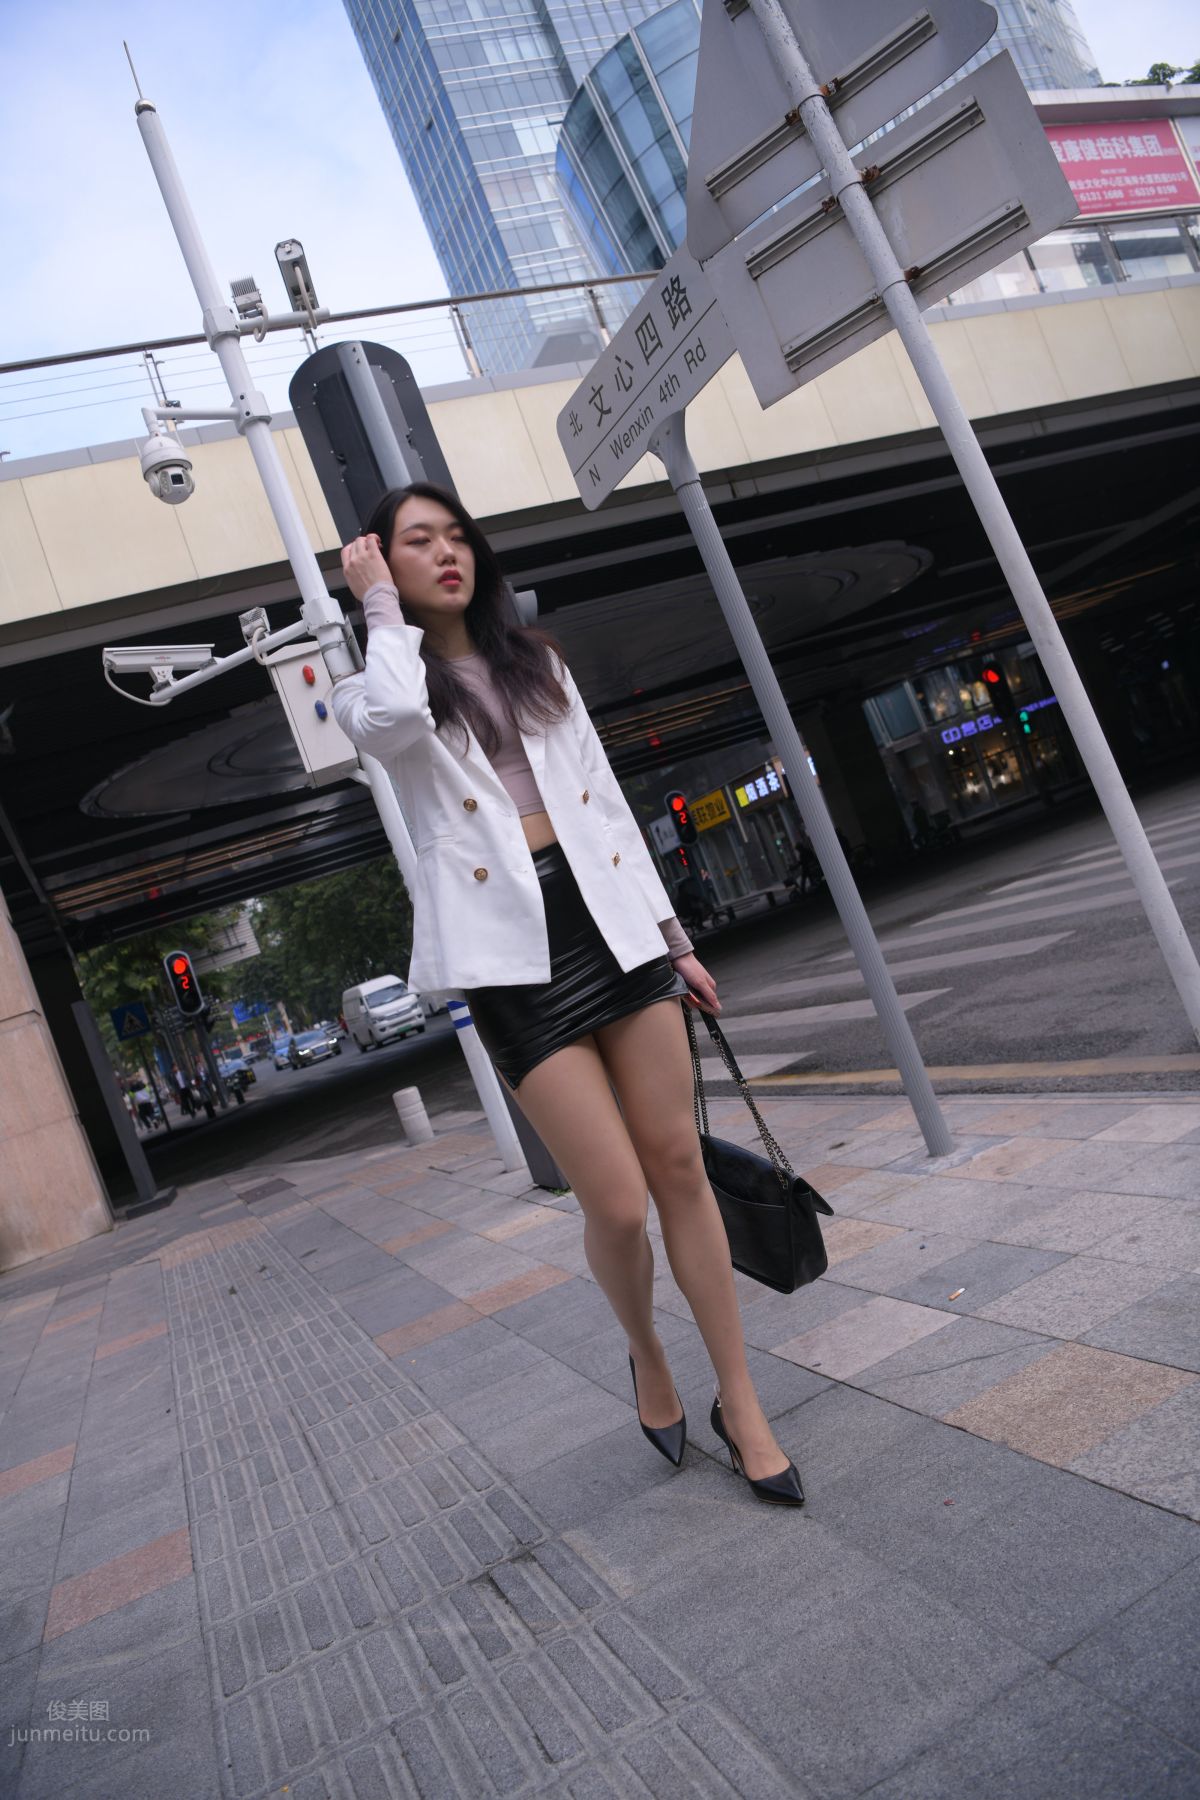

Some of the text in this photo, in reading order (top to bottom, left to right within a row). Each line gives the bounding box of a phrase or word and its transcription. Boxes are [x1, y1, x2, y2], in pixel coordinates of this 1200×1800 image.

[569, 274, 693, 437] 北 文心四路
[588, 337, 707, 487] N Wenxin 4th Rd
[680, 811, 688, 824] 2
[180, 975, 190, 989] 2
